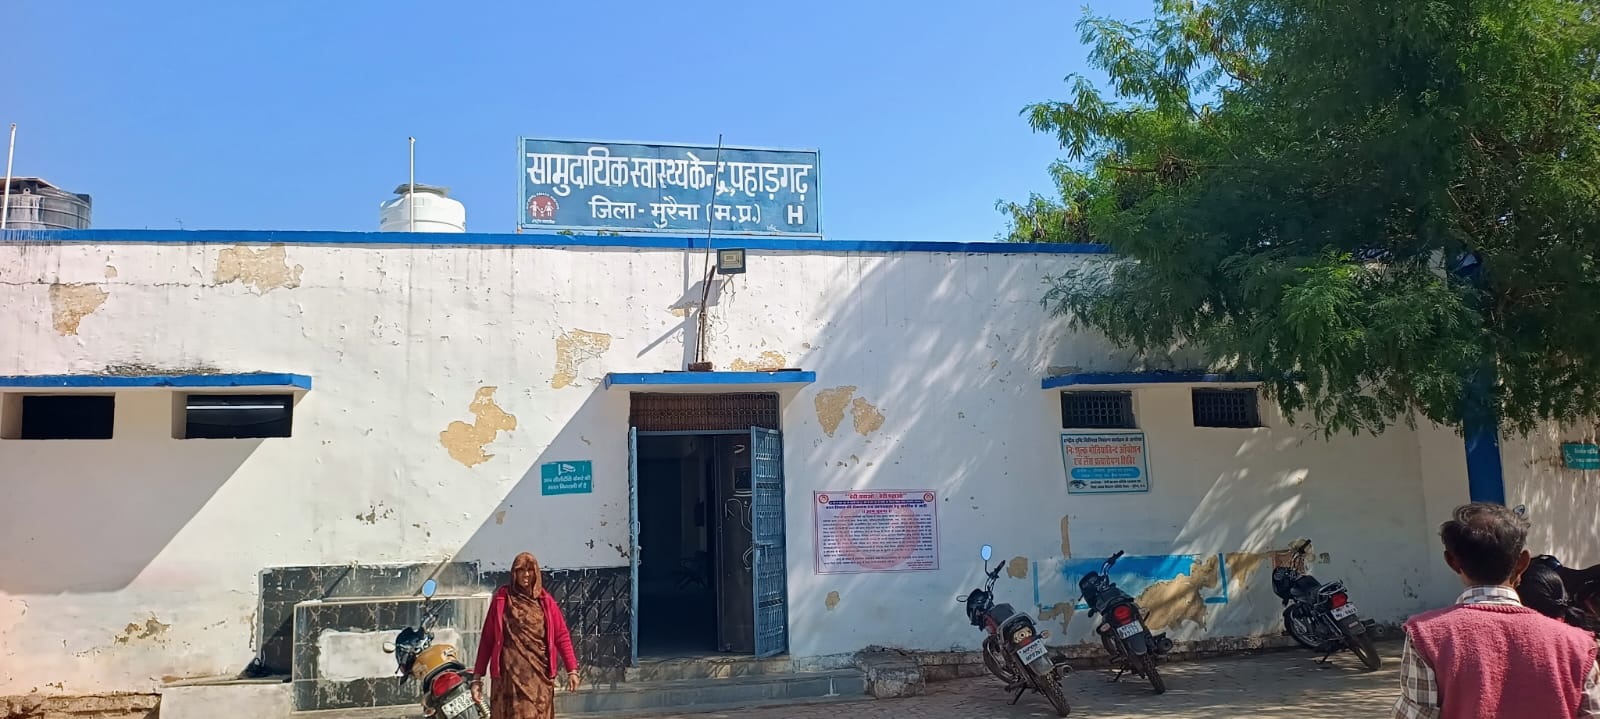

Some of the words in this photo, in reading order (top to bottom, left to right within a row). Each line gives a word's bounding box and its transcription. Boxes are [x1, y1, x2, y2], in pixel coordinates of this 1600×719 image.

[526, 146, 629, 197] सामुदायिक
[630, 157, 689, 190] स्वास्थ्य
[727, 161, 813, 202] पहाड़गढ़
[588, 195, 637, 219] जिला
[649, 195, 701, 229] मुरैना
[787, 205, 804, 225] H
